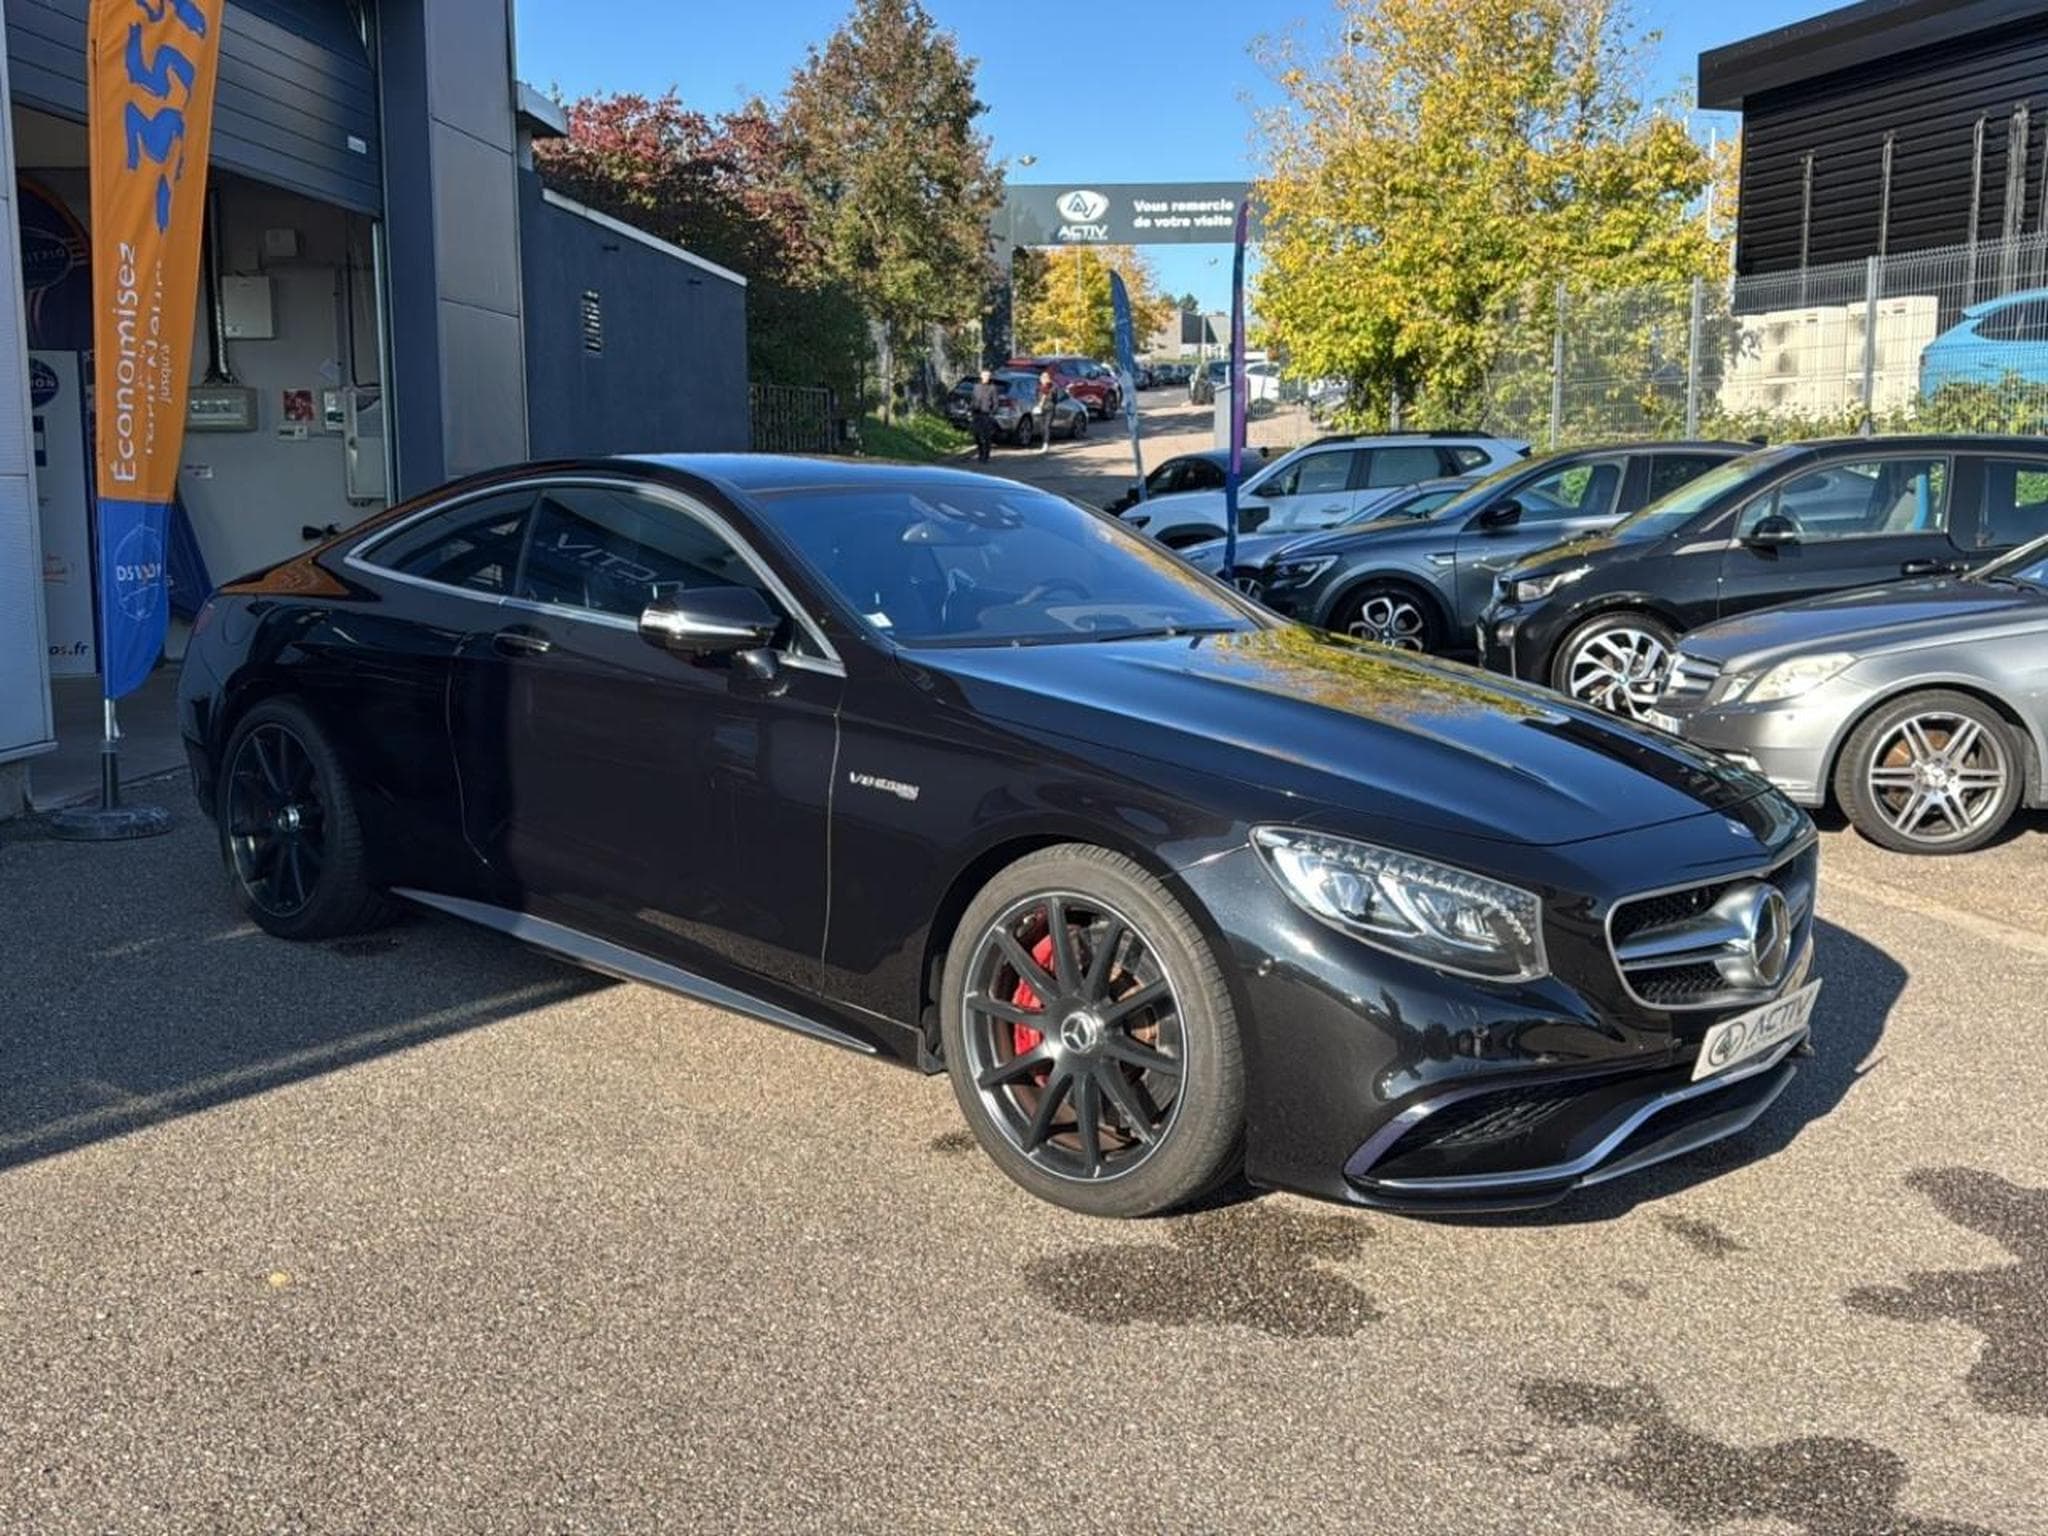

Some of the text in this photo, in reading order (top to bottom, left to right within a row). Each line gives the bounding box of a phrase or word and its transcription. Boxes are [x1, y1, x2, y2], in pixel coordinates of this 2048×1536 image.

[1133, 198, 1235, 212] Vous remercie
[1133, 215, 1233, 229] de votre visite
[1057, 224, 1108, 237] ACTIV
[110, 242, 138, 482] Économisez
[48, 641, 89, 656] os.fr
[1748, 990, 1814, 1041] ACTIV
